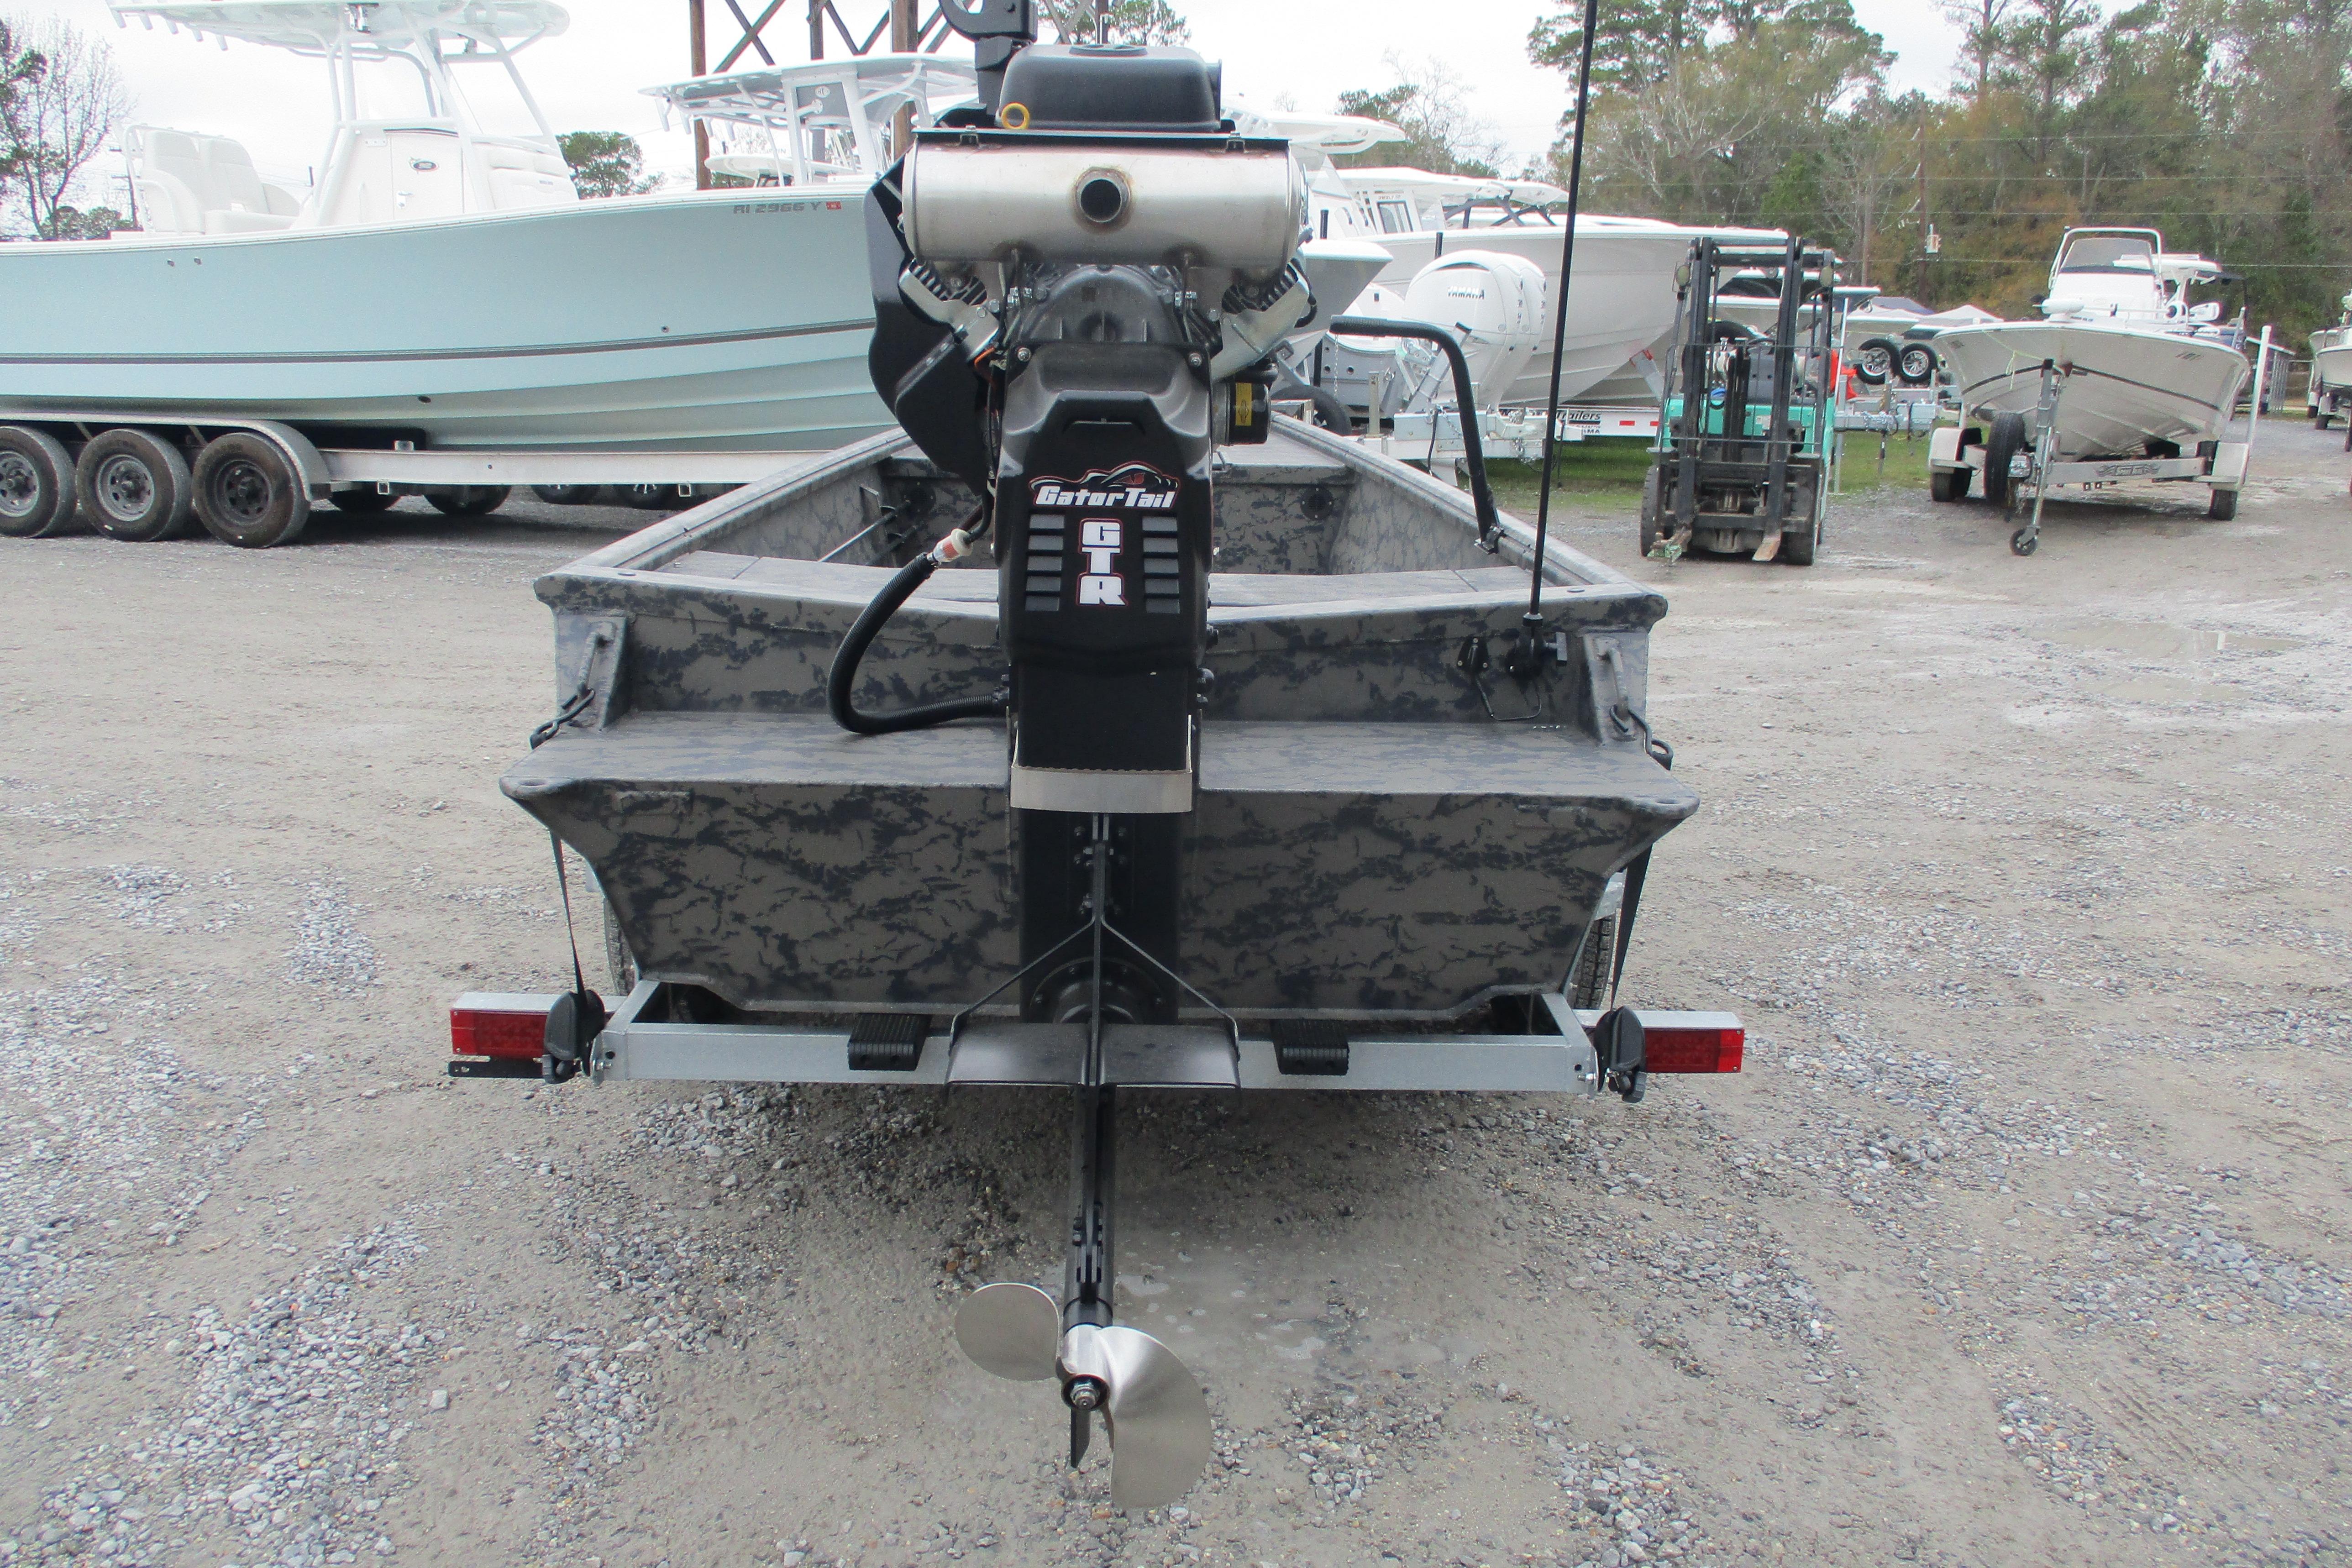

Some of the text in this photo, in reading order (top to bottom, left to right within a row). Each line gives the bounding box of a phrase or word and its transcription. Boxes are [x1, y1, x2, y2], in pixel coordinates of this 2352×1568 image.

[810, 201, 821, 211] Y
[1035, 485, 1176, 508] GatorTail
[1079, 522, 1125, 605] GTR
